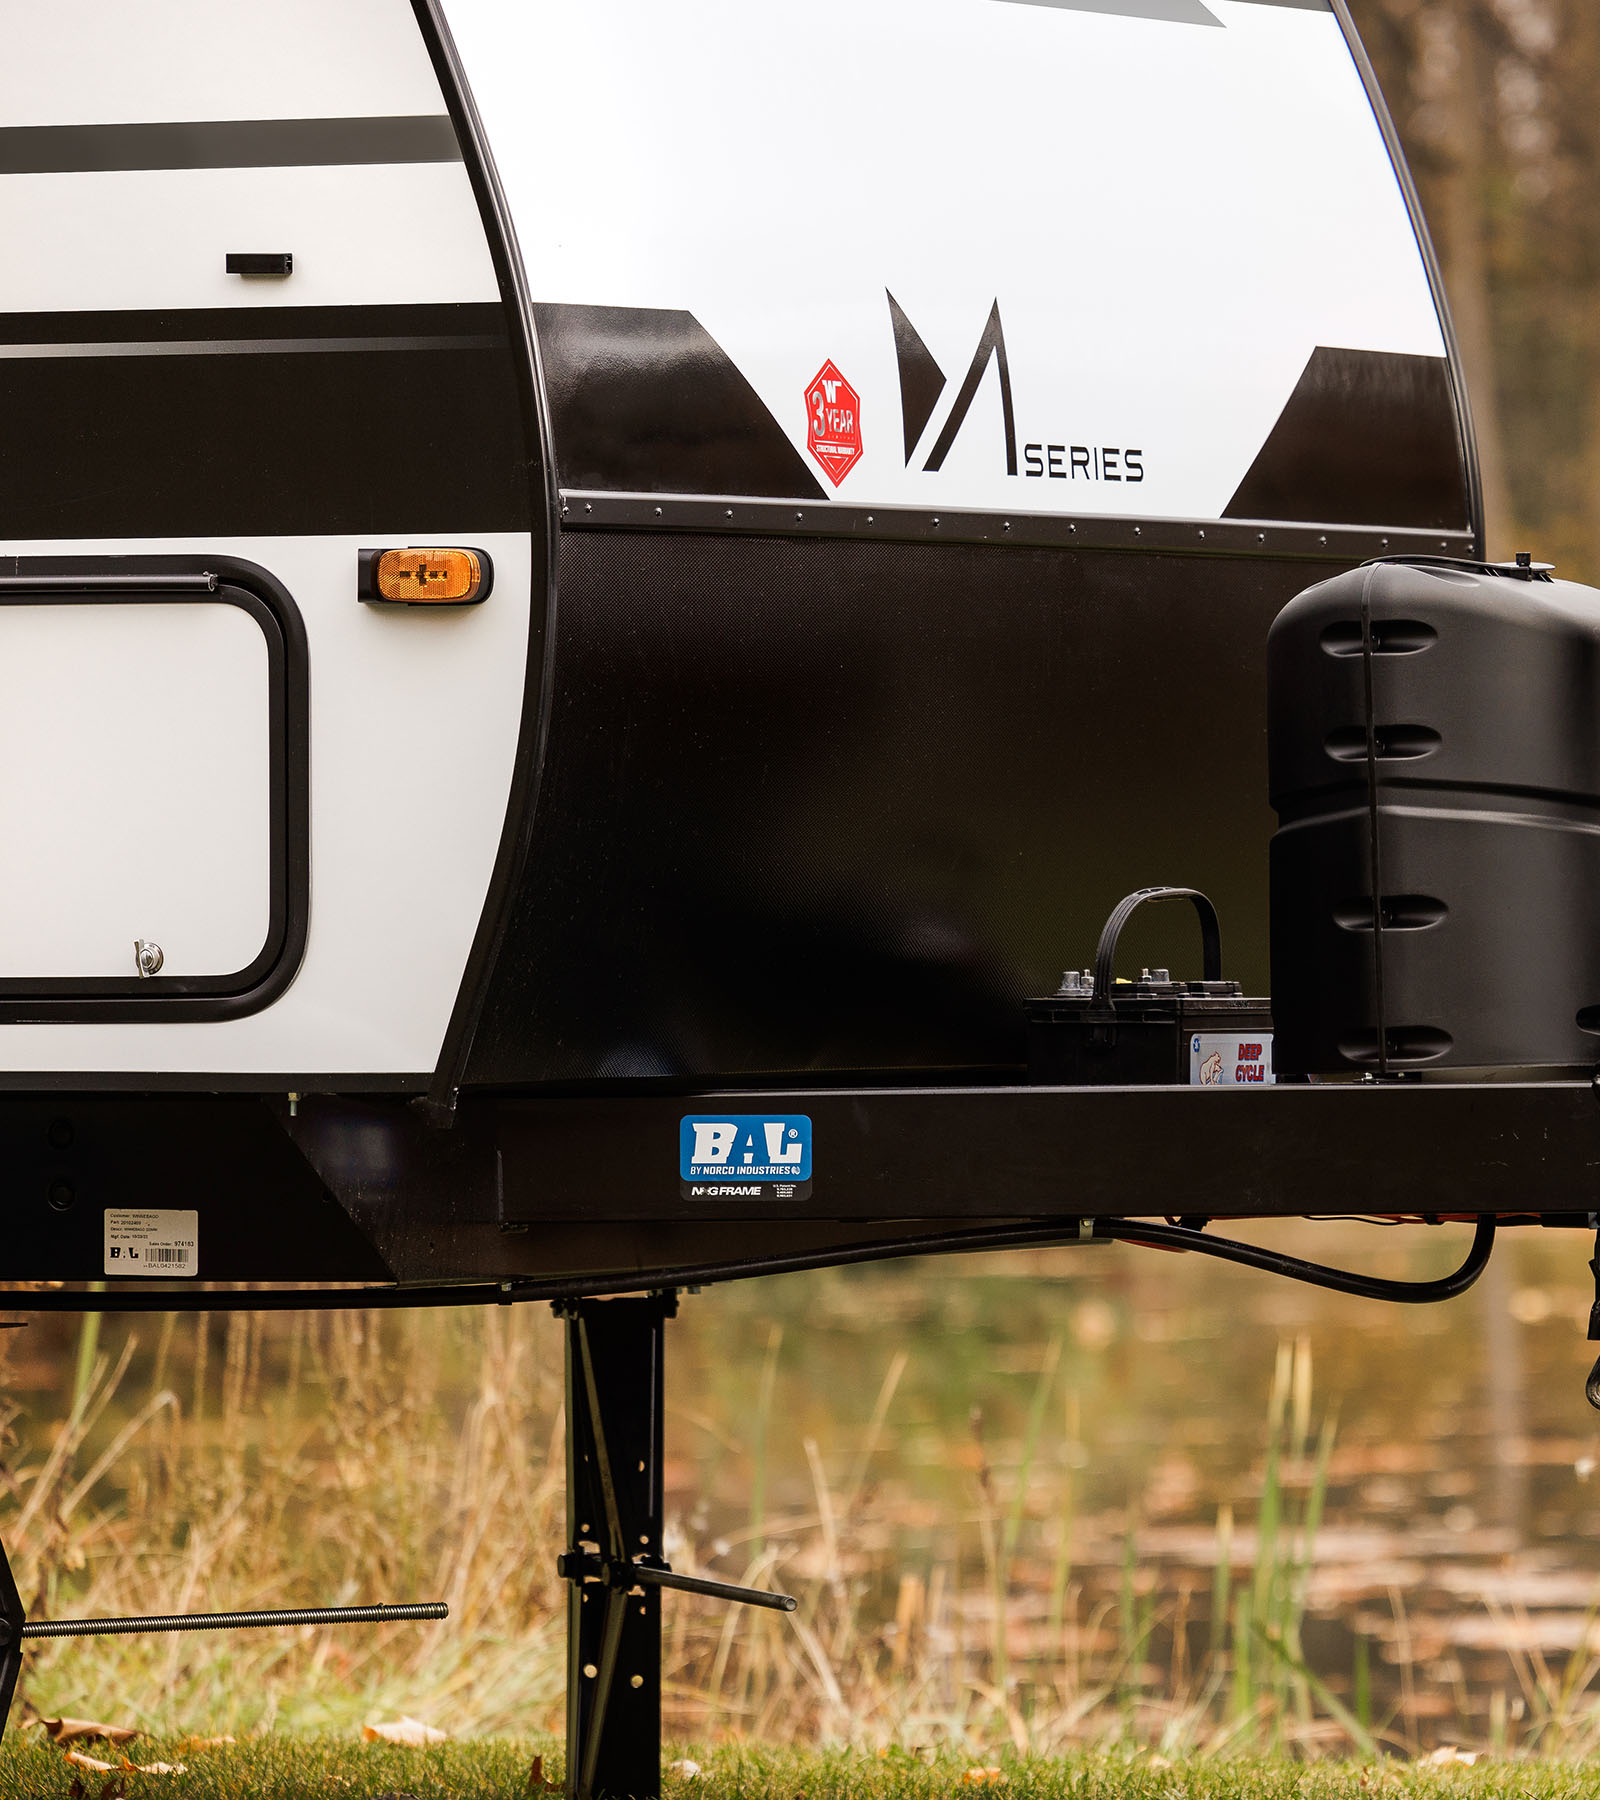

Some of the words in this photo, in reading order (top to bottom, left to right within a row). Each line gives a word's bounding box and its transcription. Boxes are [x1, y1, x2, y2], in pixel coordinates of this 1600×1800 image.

[812, 390, 825, 437] 3
[825, 408, 854, 434] YEAR
[1024, 443, 1144, 482] SERIES
[1238, 1043, 1263, 1061] DEEP
[1235, 1065, 1265, 1082] CYCLE
[691, 1122, 803, 1164] BAL
[690, 1166, 702, 1175] BY
[703, 1166, 734, 1175] NORCO
[736, 1166, 790, 1175] INDUSTRIES
[719, 1187, 762, 1196] FRAME
